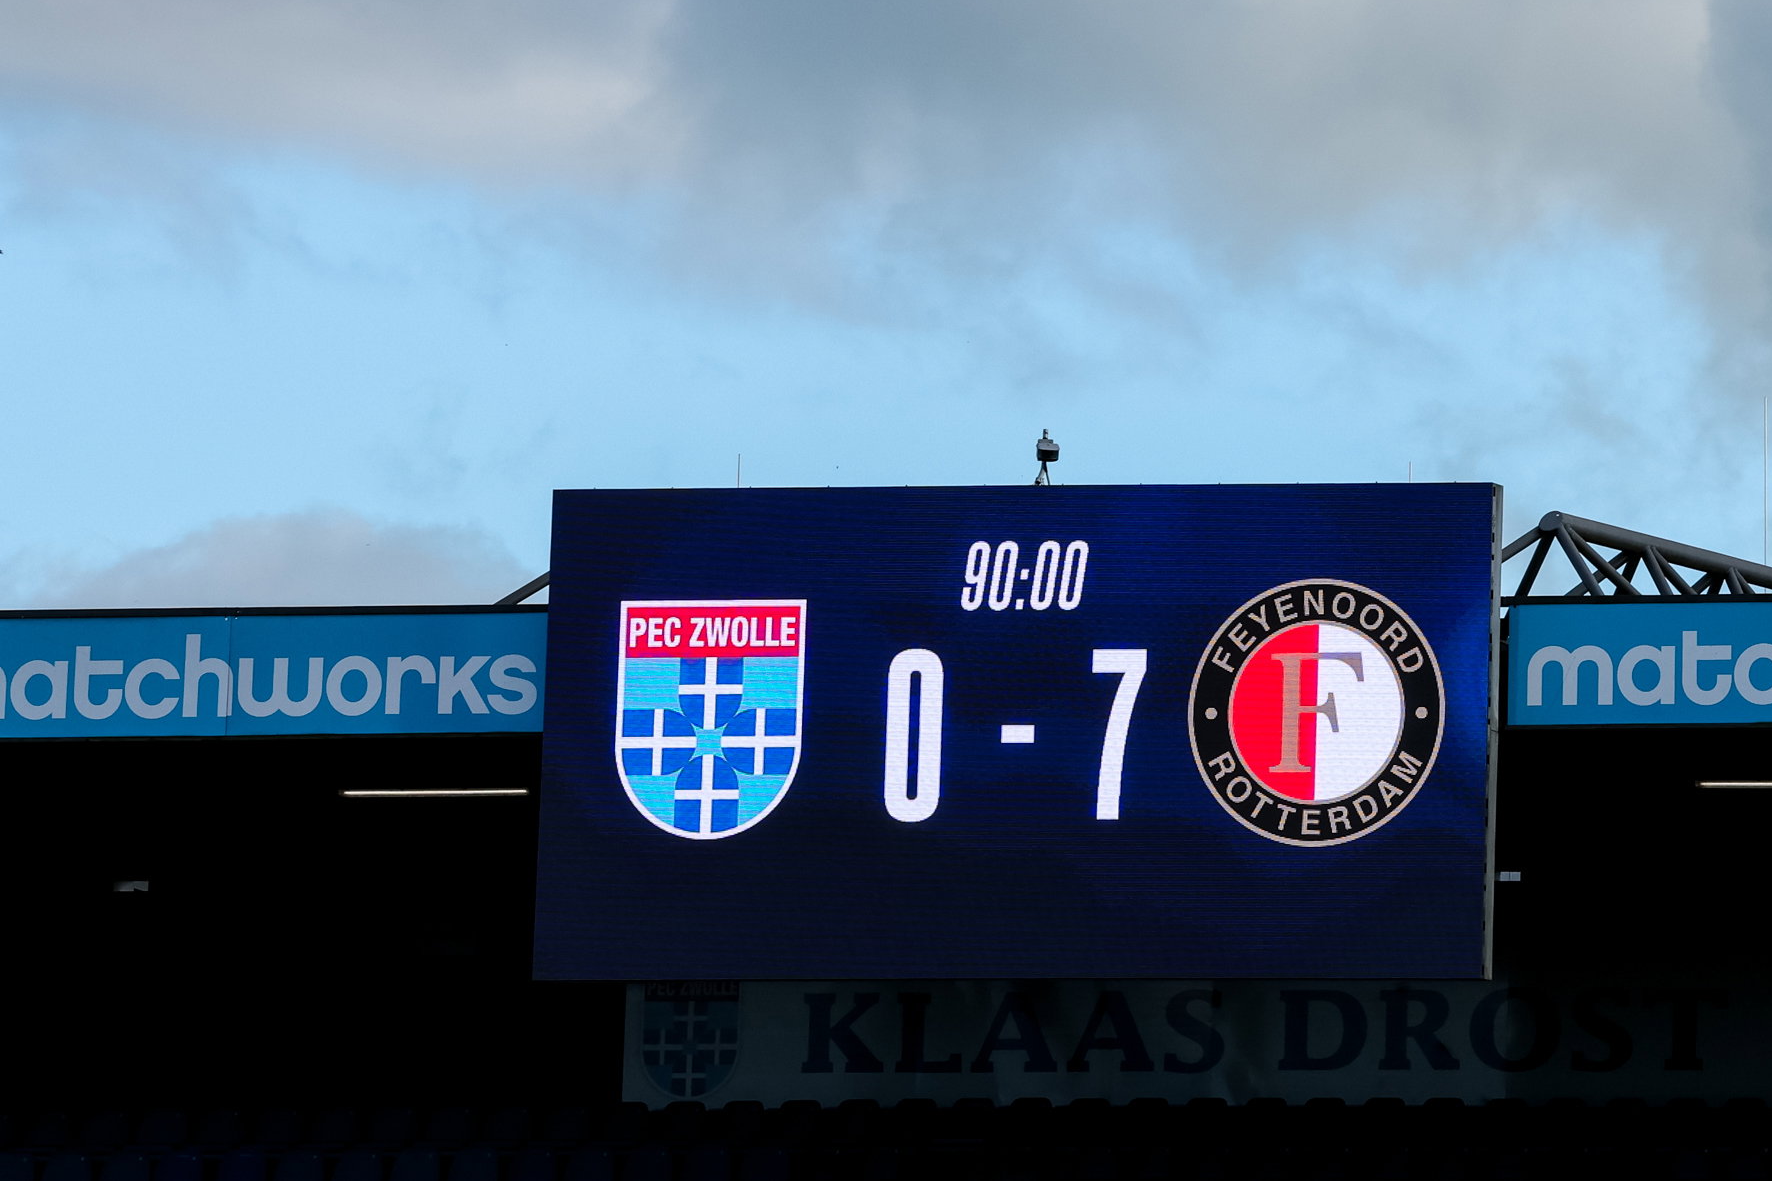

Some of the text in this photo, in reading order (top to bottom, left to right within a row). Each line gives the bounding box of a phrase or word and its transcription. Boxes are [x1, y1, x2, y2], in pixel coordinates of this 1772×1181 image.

[961, 540, 1089, 611] 90:00
[629, 616, 796, 648] PEC ZWOLLE
[1211, 589, 1424, 674] FEYENOORD
[0, 634, 537, 719] atchworks
[1268, 652, 1364, 773] F
[884, 648, 944, 823] 0
[1092, 649, 1148, 820] 7
[1208, 751, 1423, 835] ROTTERDAM
[801, 989, 1225, 1075] KLAAS
[1278, 987, 1727, 1074] DROST
